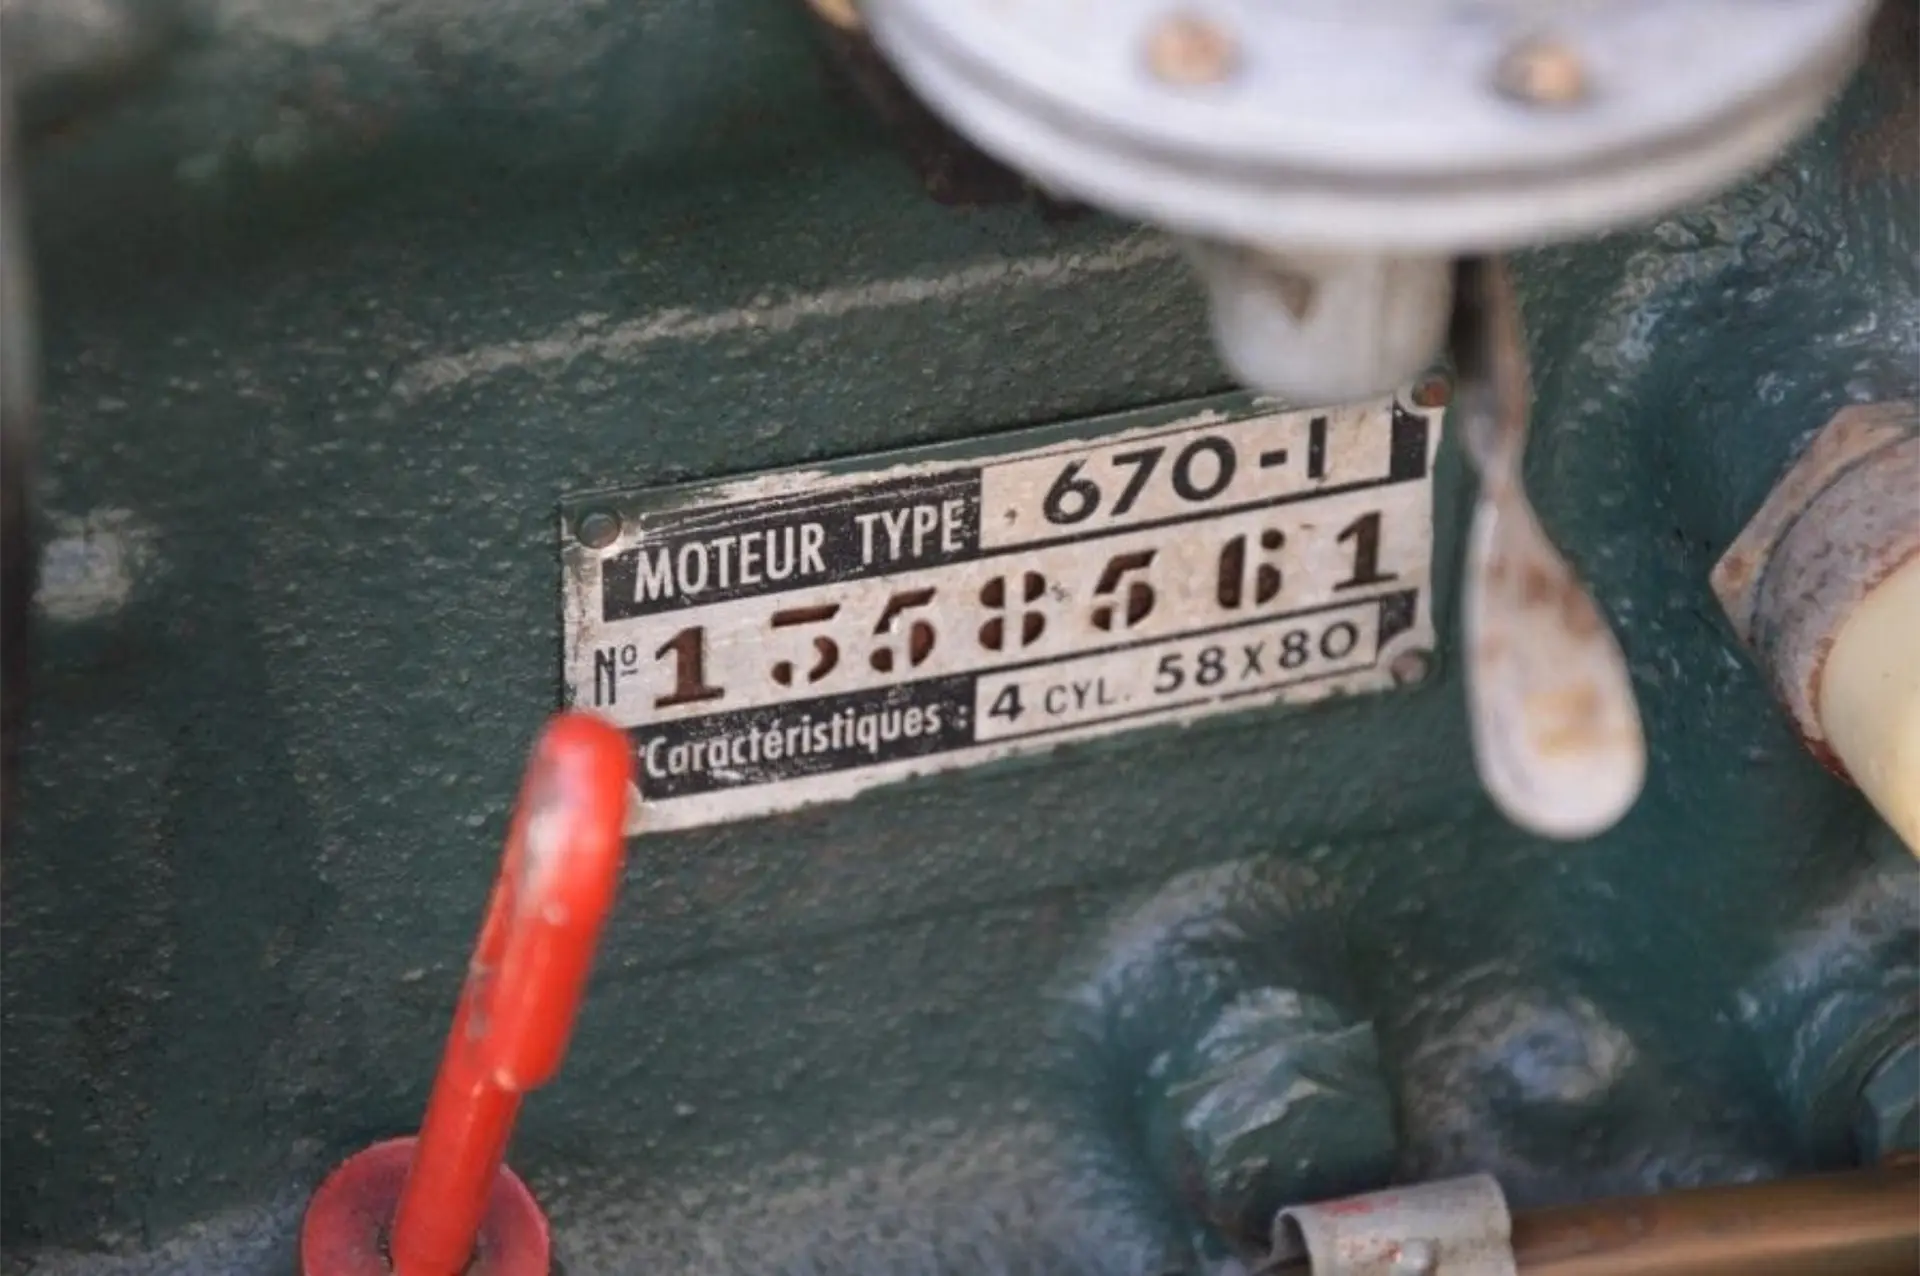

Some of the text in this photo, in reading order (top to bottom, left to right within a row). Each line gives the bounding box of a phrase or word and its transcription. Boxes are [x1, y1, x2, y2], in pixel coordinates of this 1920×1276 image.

[633, 522, 826, 603] MOTEUR
[854, 499, 965, 566] TYPE
[988, 684, 1024, 722] 4
